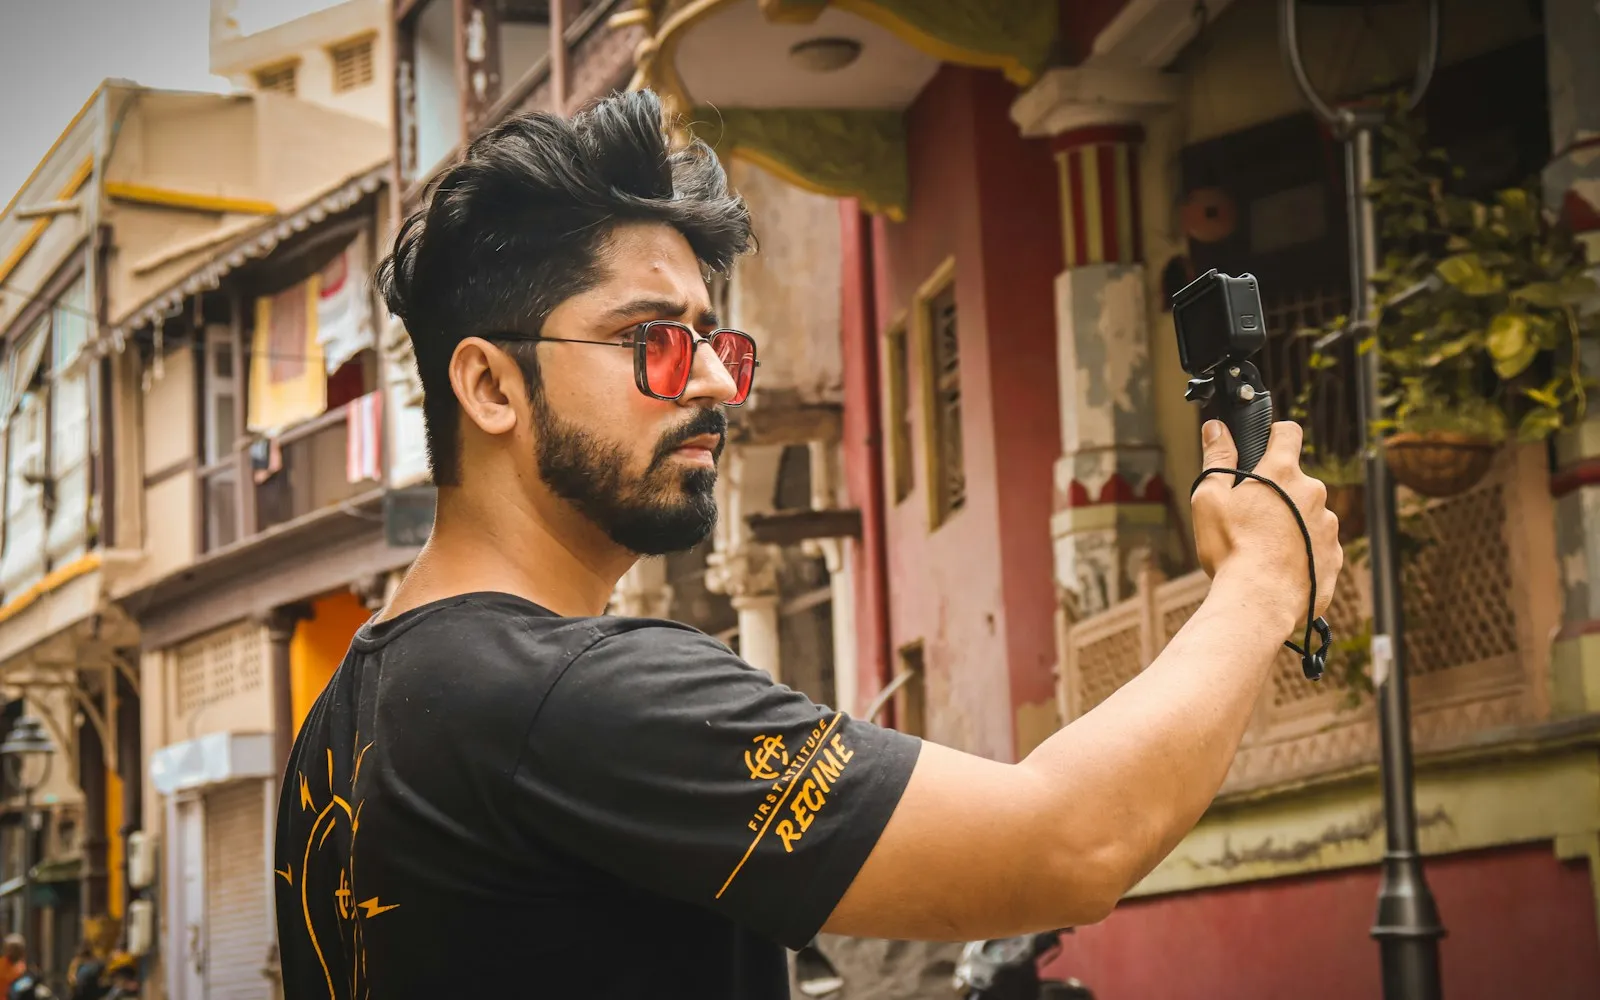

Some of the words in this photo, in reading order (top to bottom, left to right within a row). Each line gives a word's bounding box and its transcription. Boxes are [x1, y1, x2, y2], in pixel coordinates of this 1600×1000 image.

[748, 782, 783, 831] FIRST
[781, 719, 827, 781] ATTITUDE
[775, 733, 854, 853] REGIME
